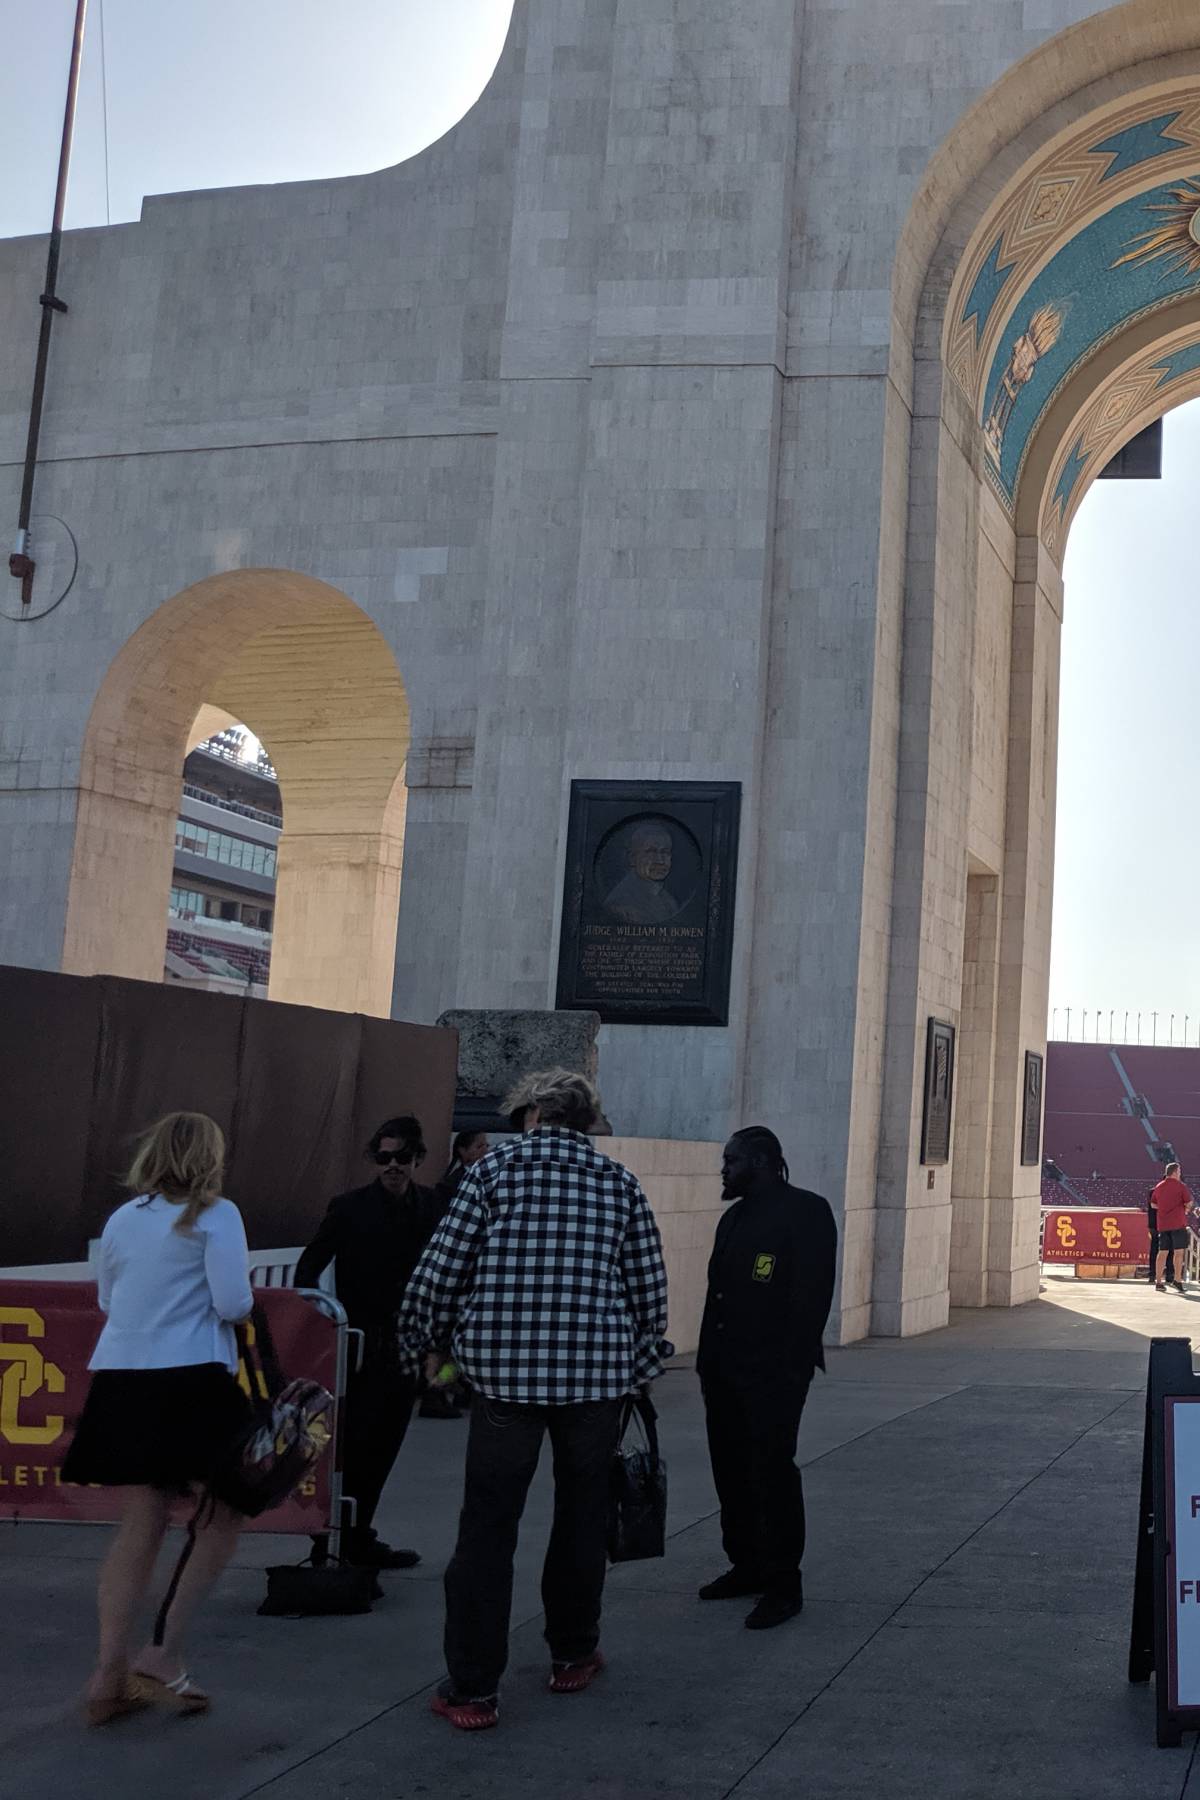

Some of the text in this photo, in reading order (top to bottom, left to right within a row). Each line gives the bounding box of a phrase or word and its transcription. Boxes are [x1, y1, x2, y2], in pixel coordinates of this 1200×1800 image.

[584, 926, 704, 937] JUDGE WILLIAM M BOWEN
[1056, 1215, 1076, 1248] SC
[1102, 1217, 1122, 1249] SC
